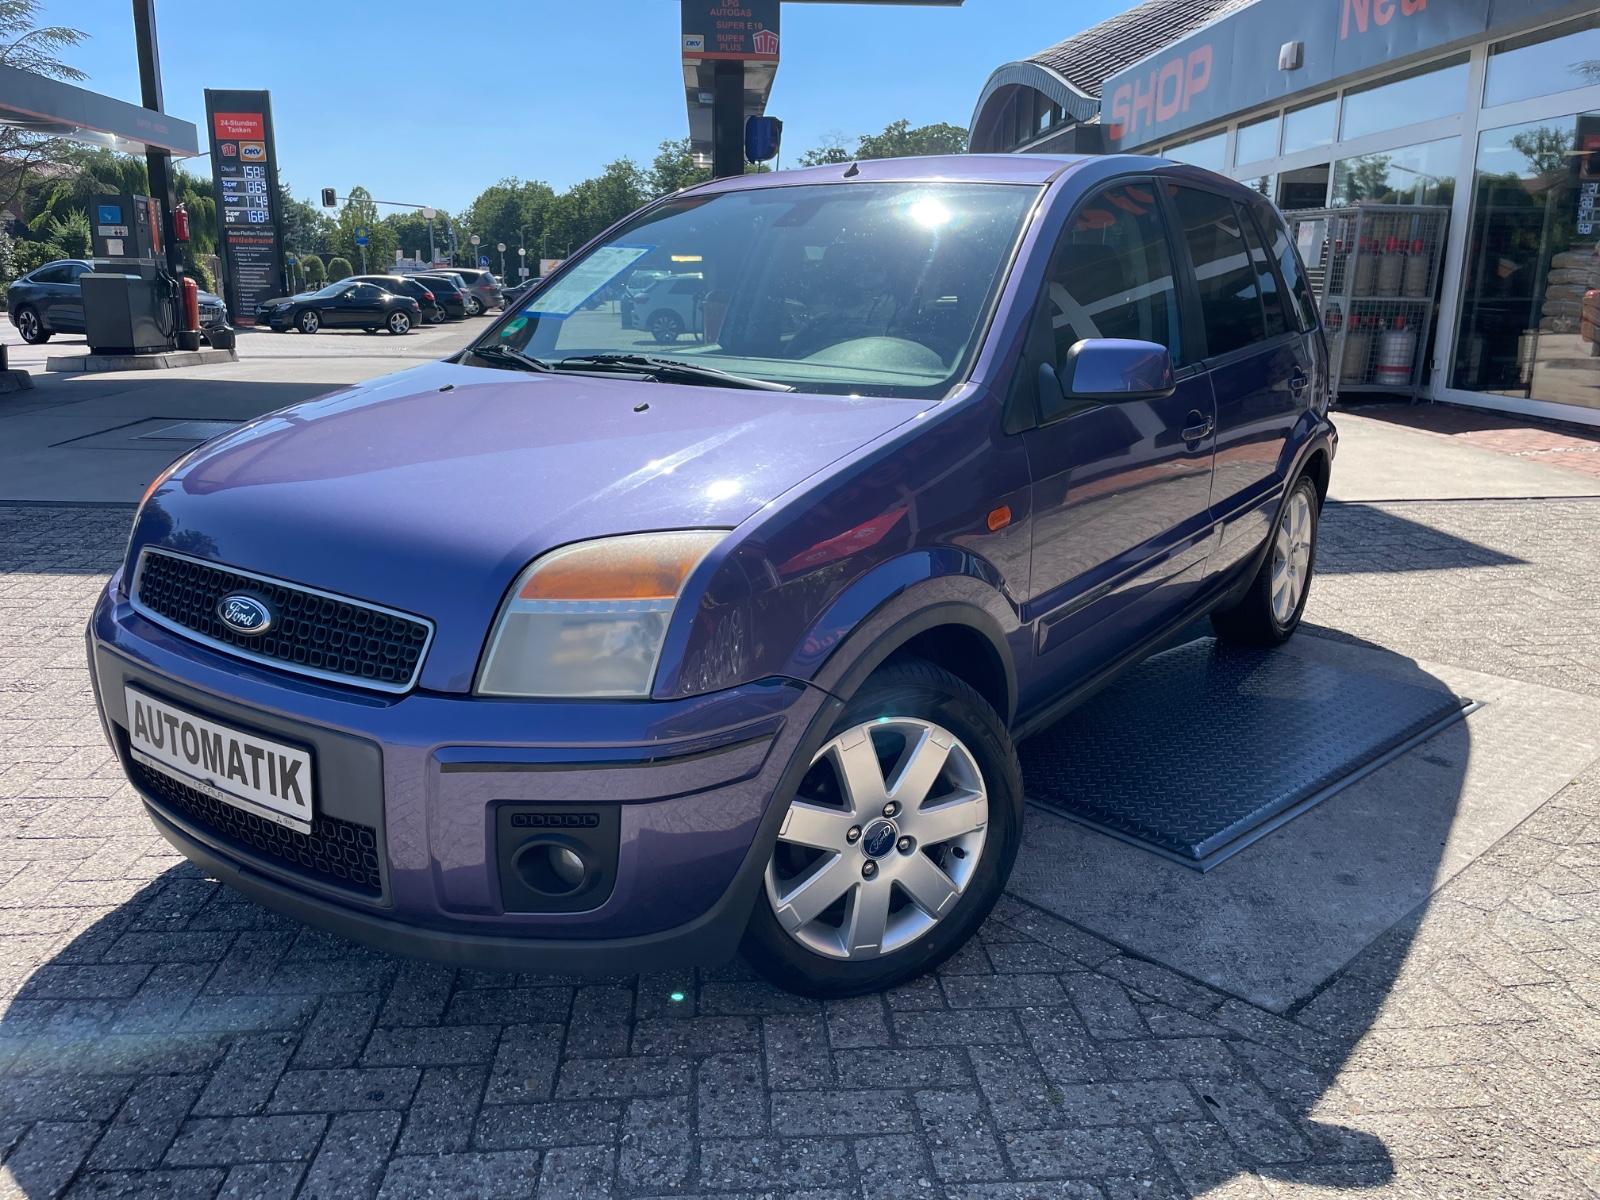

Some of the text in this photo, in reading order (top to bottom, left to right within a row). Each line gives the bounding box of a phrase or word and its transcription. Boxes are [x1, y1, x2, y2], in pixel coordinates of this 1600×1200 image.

[710, 8, 752, 17] AUTOGAS
[716, 20, 745, 29] SUPER
[716, 34, 745, 42] SUPER
[720, 43, 742, 51] PLUS
[1109, 44, 1214, 141] SHOP
[220, 119, 257, 127] 24-Stunden
[224, 600, 256, 626] Ford
[134, 699, 306, 807] AUTOMATIK
